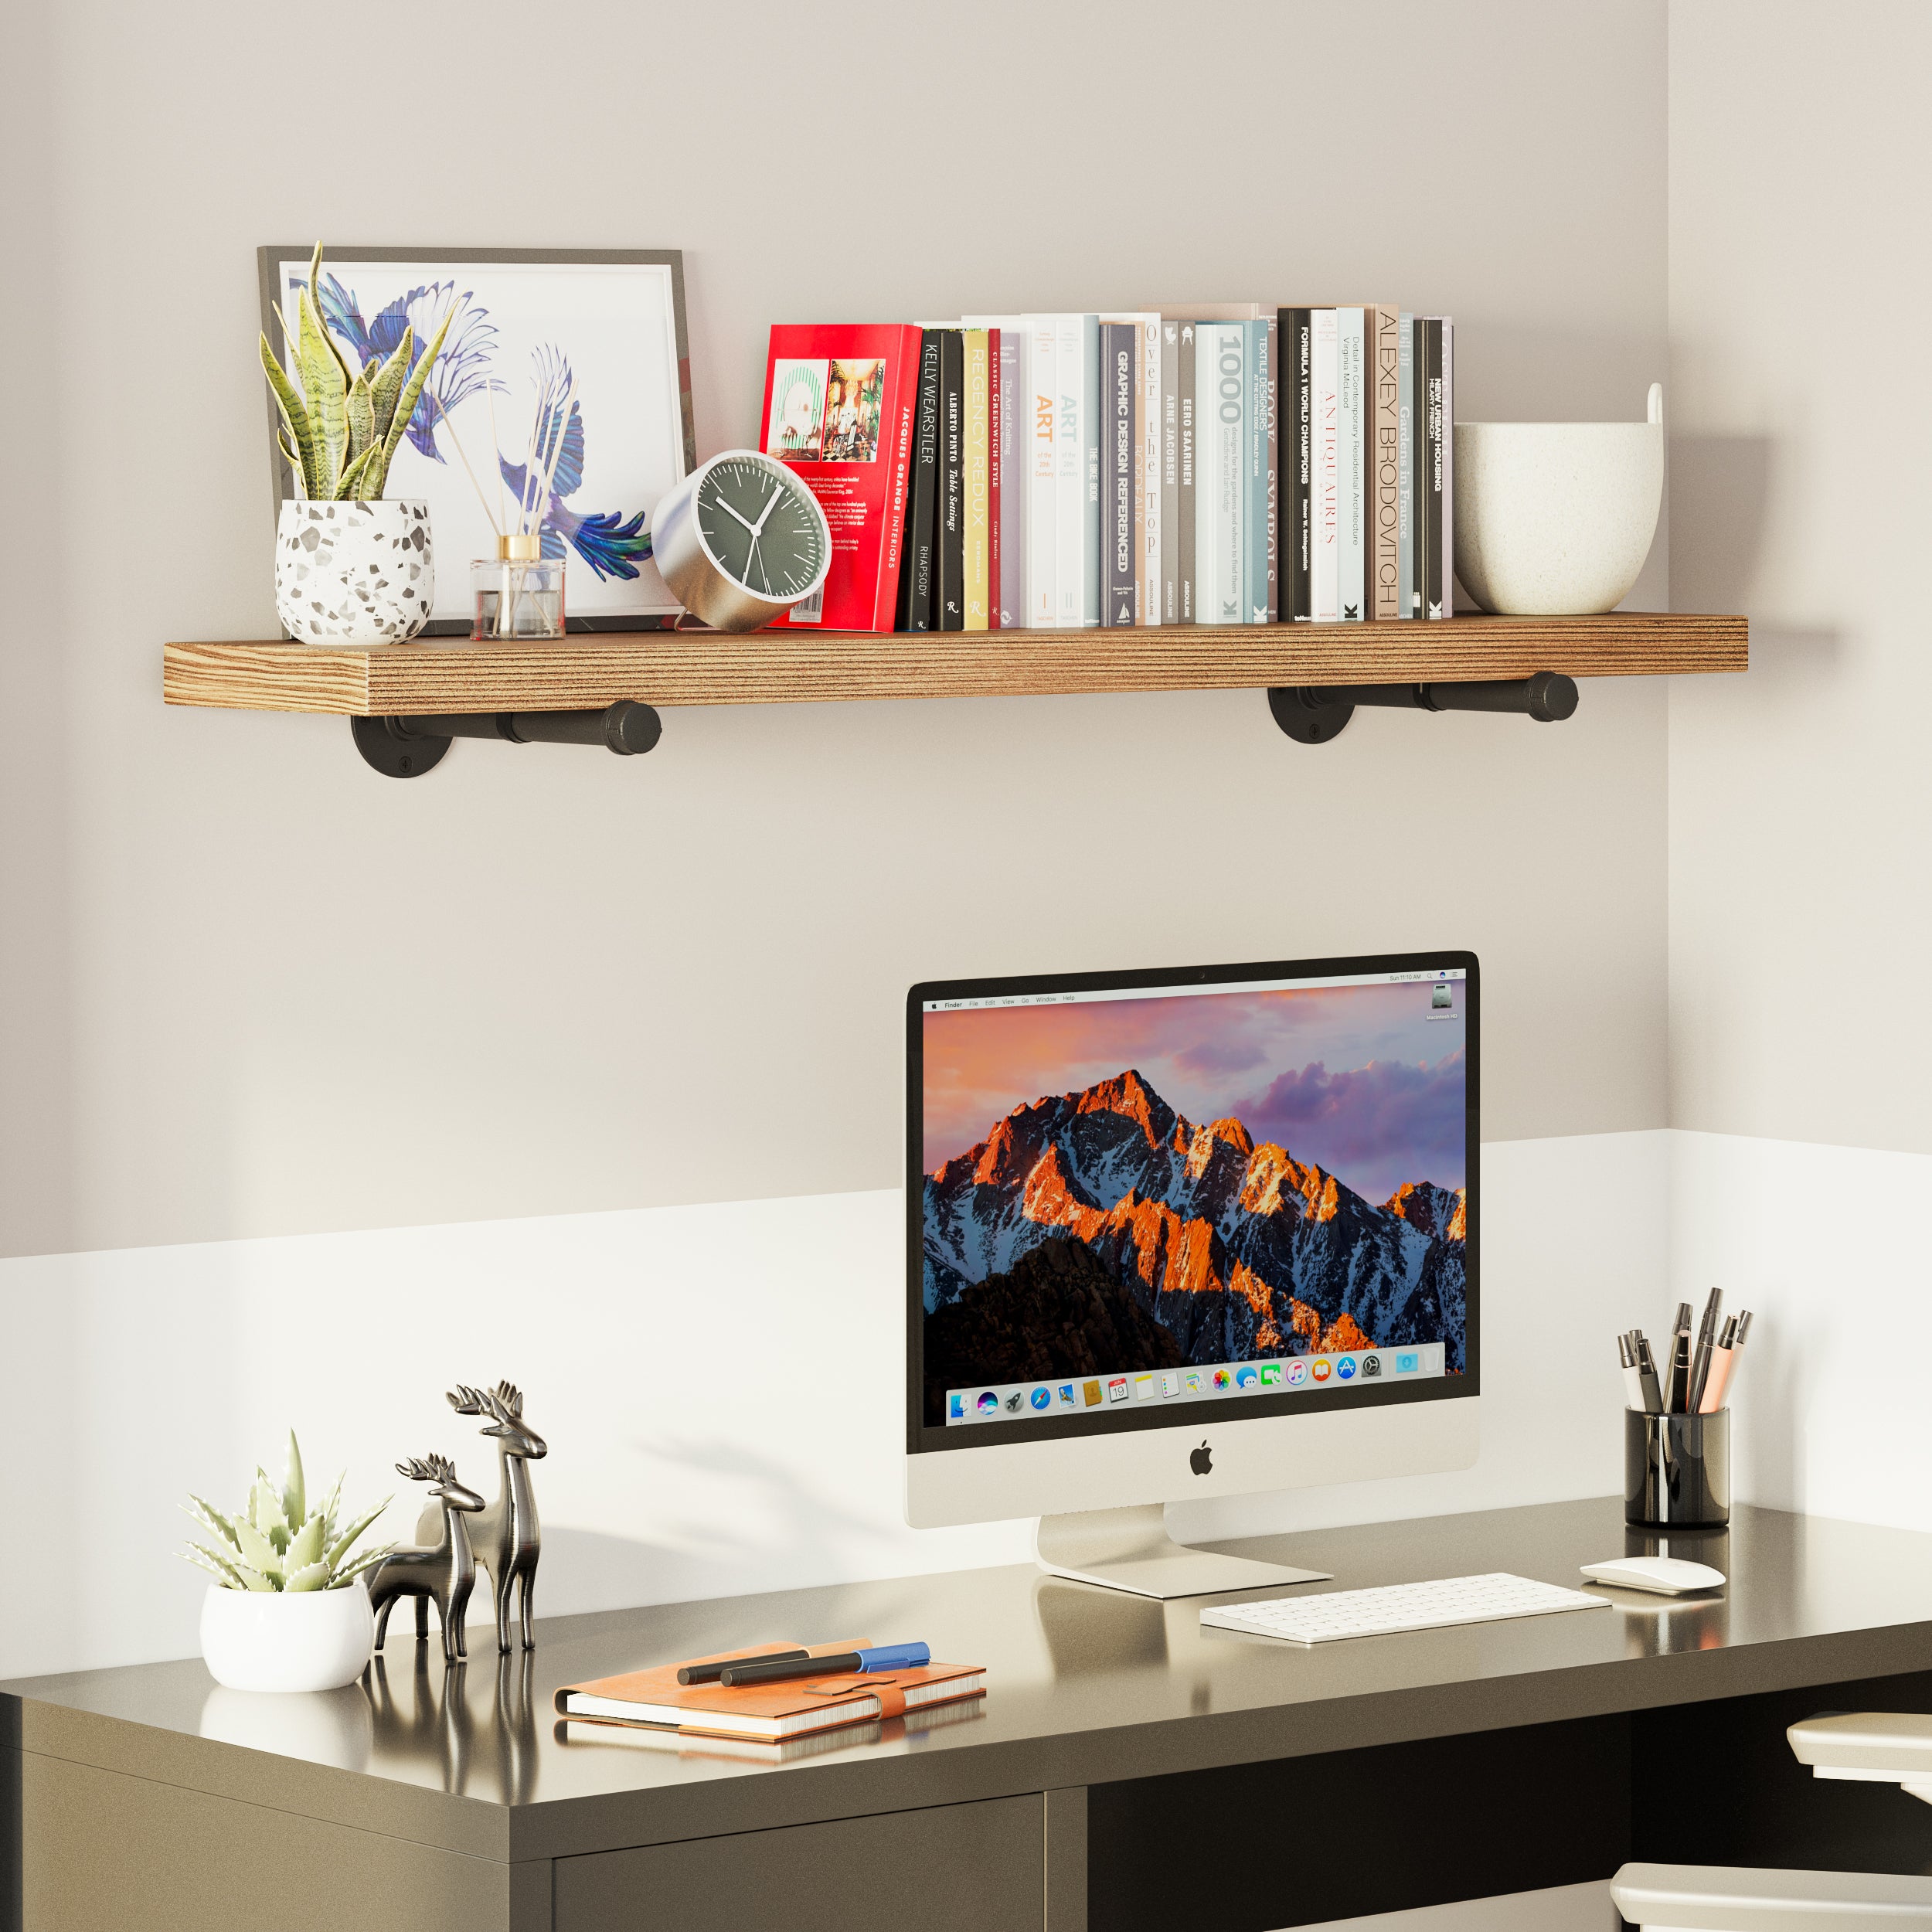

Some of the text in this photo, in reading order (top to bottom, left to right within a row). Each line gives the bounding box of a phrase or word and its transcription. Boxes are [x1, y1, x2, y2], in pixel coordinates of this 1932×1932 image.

[1342, 336, 1350, 370] Virginia
[921, 344, 937, 464] KELLY WEARSTLER
[1219, 335, 1242, 424] 1000
[900, 406, 910, 458] JACQUES
[1006, 412, 1012, 421] of
[1036, 395, 1053, 443] ART
[1061, 395, 1077, 443] ART
[1351, 375, 1360, 438] Contemporary
[947, 391, 957, 532] ALBERTO PINTO Table Settings
[971, 349, 984, 526] REGENCY REDUX
[1117, 351, 1128, 573] GRAPHIC DESIGN REFERENCED
[1228, 427, 1238, 454] designs
[1379, 311, 1396, 603] ALEXEY BRODOVITCH
[894, 464, 905, 511] GRANGE
[1323, 390, 1336, 544] ANTIQUAIRES
[1400, 406, 1410, 539] Gardens in France
[1222, 491, 1230, 513] Rudge
[1228, 481, 1238, 511] gardens
[888, 515, 900, 569] INTERIORS
[918, 546, 929, 597] RHAPSODY
[1063, 994, 1075, 1002] Help
[1113, 1386, 1124, 1397] 19
